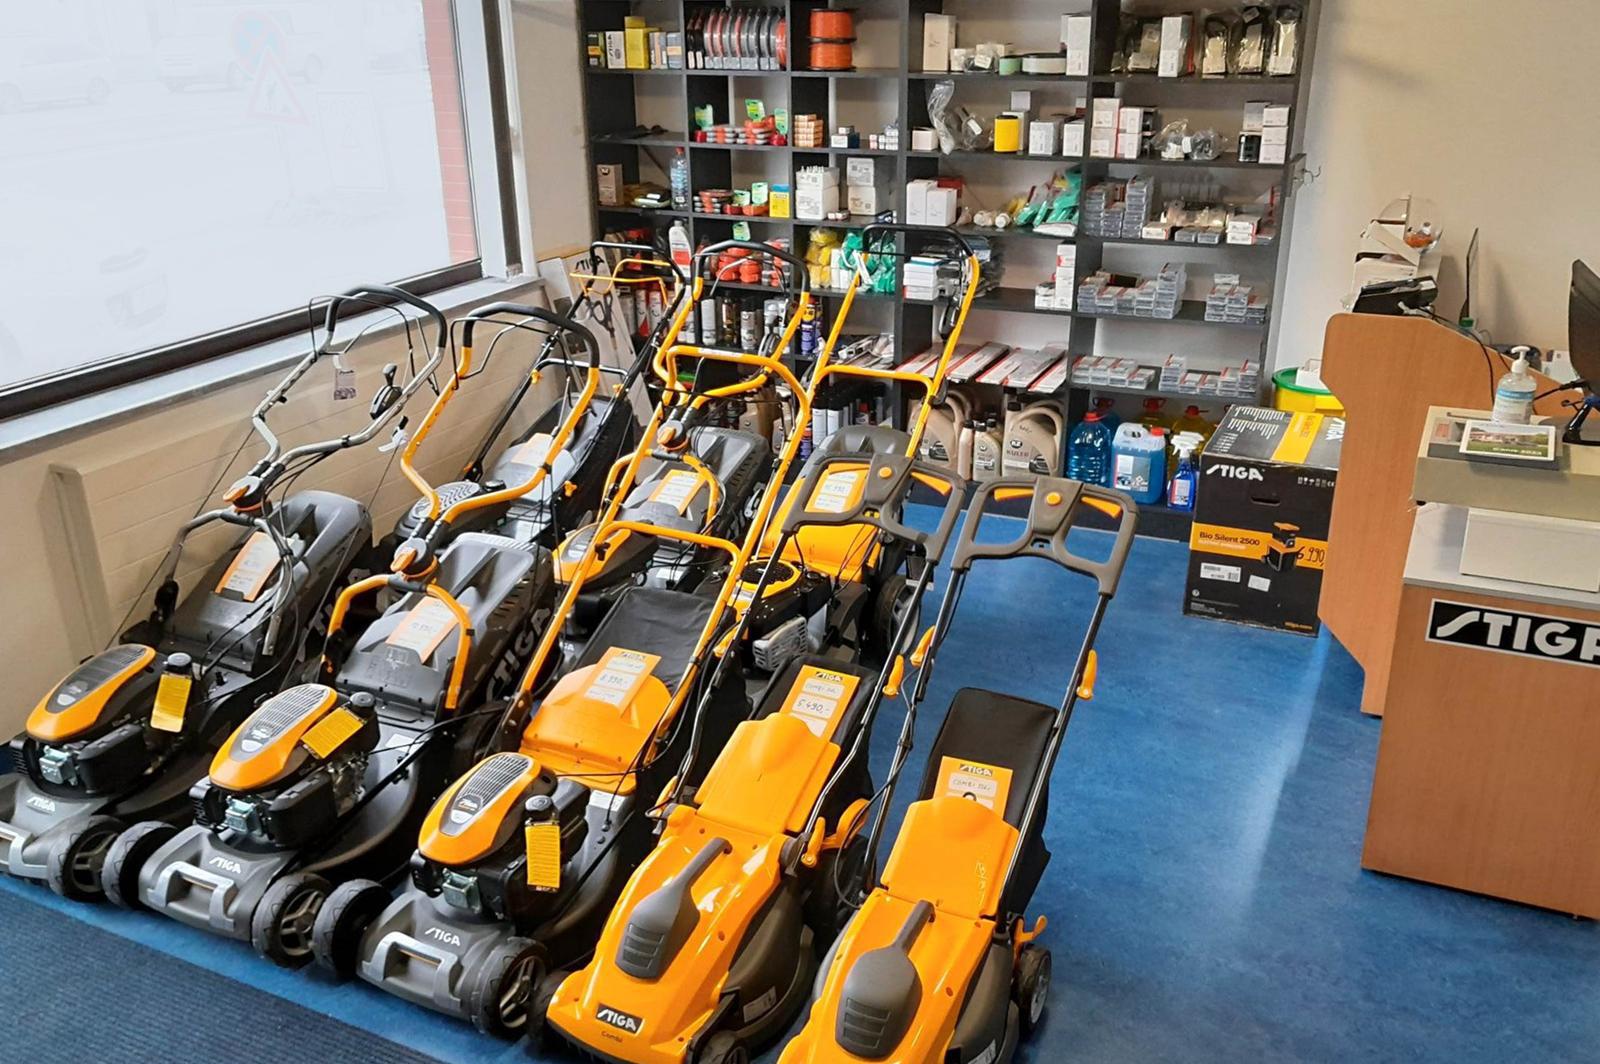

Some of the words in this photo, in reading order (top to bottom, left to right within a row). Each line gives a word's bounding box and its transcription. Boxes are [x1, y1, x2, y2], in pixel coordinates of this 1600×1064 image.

[575, 255, 605, 270] STIA
[1206, 464, 1264, 482] STIGA
[1200, 531, 1213, 540] Bio
[1215, 533, 1239, 543] Silent
[1240, 537, 1260, 546] 2500
[816, 671, 843, 681] STIGA
[959, 764, 993, 777] STIGA
[209, 857, 242, 874] STIGA
[425, 927, 461, 947] STIGA
[597, 1009, 637, 1031] STIGA
